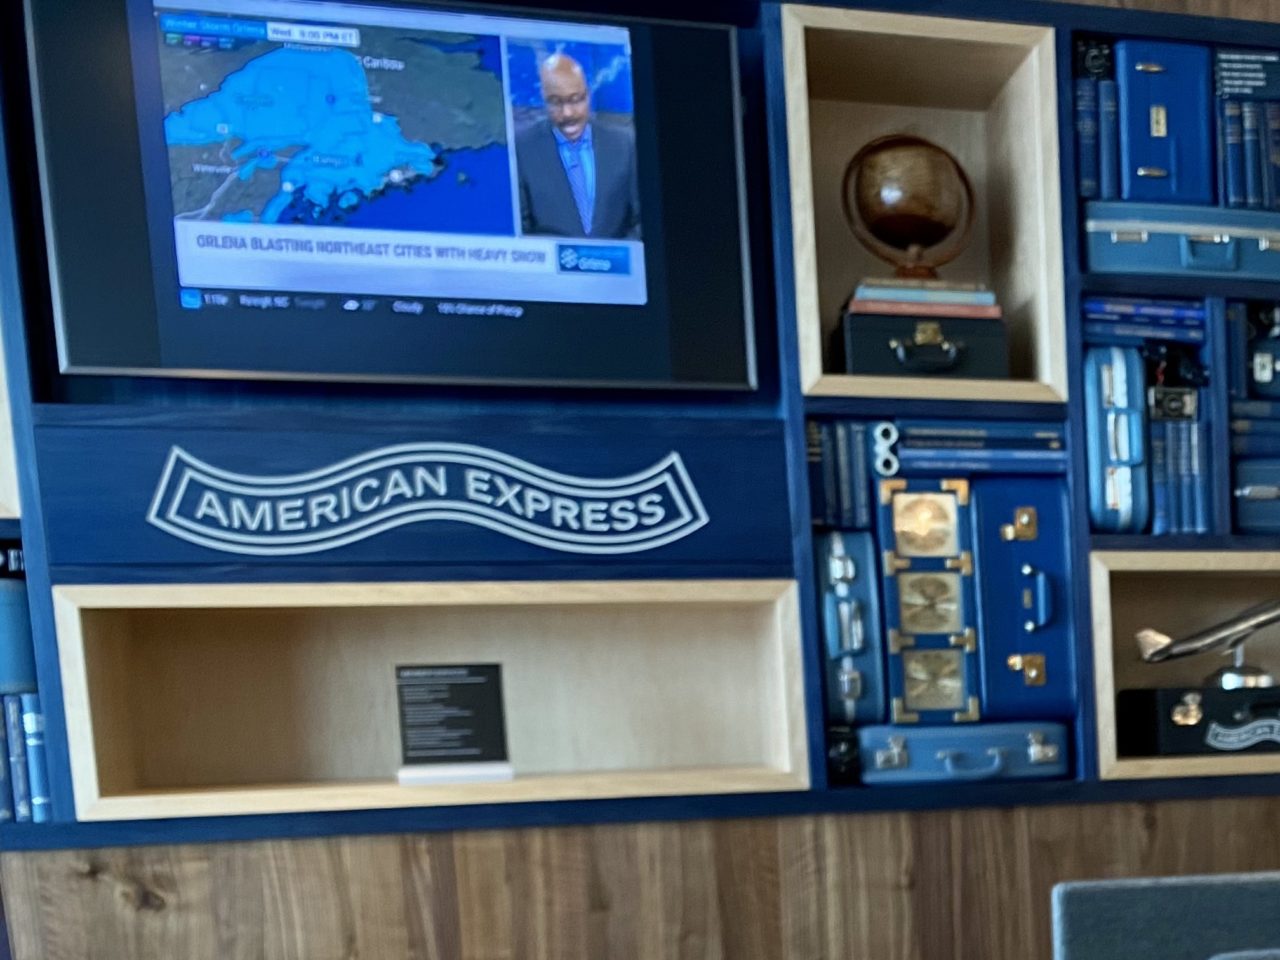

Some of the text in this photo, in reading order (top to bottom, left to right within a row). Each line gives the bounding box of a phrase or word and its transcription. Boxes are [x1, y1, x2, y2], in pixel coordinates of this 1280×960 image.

[251, 236, 314, 253] BLASTING
[316, 241, 390, 256] NORTHEAST
[393, 243, 432, 259] CITIES
[433, 246, 465, 260] WITH
[468, 248, 507, 262] HEAVY
[511, 249, 546, 263] SNOW
[195, 464, 667, 533] AMERICAN EXPRESS
